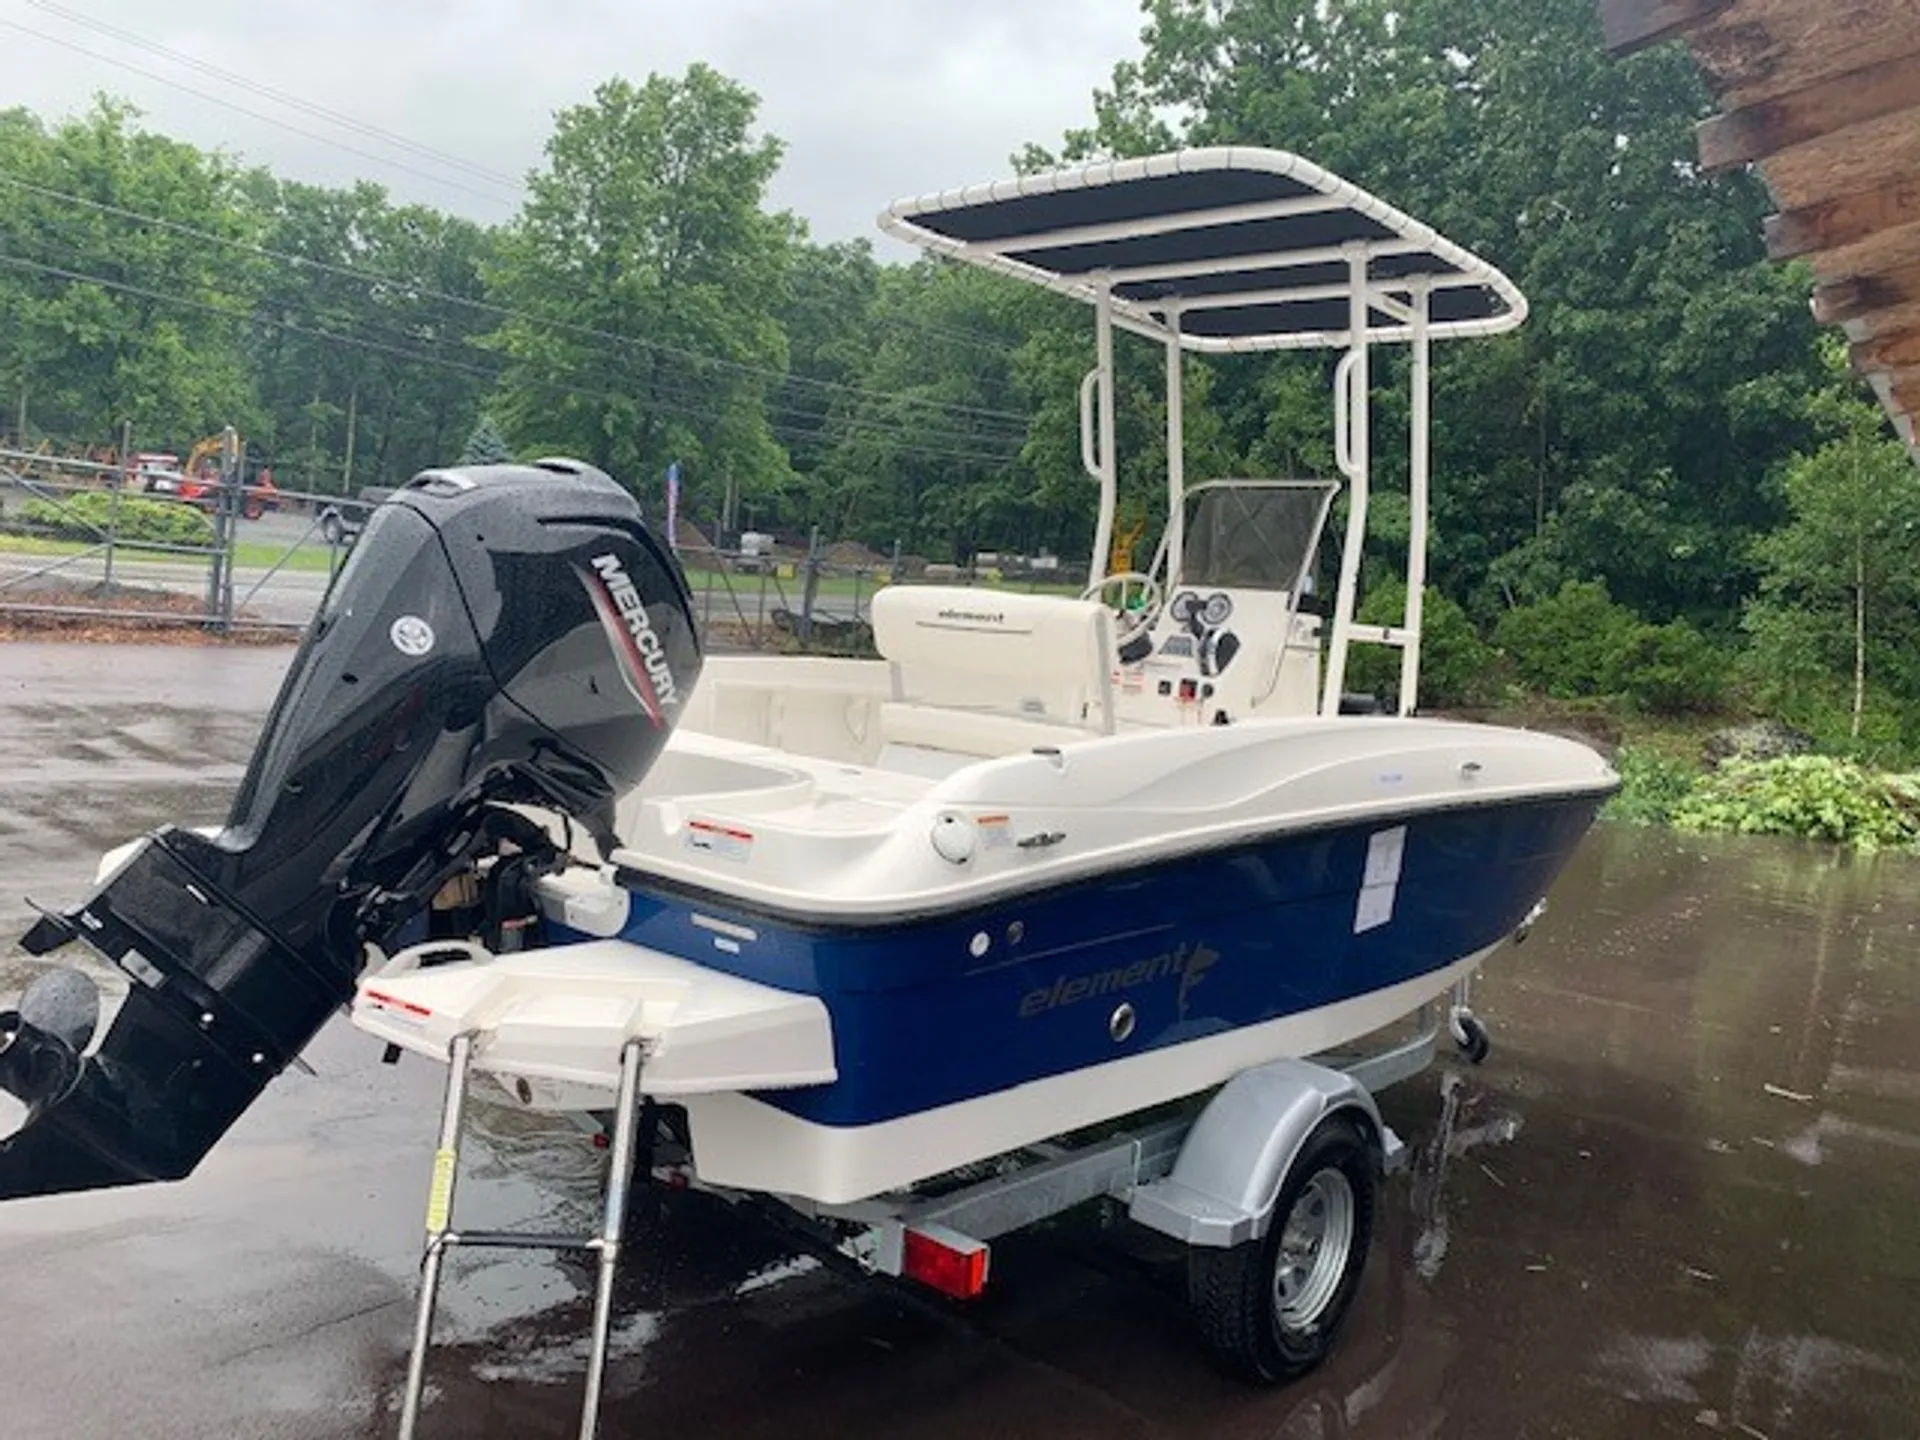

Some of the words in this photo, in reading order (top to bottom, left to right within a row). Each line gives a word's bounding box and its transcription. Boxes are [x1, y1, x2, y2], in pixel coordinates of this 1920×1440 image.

[591, 553, 678, 705] MERCURY
[938, 608, 1004, 625] element
[1017, 941, 1189, 1018] element
